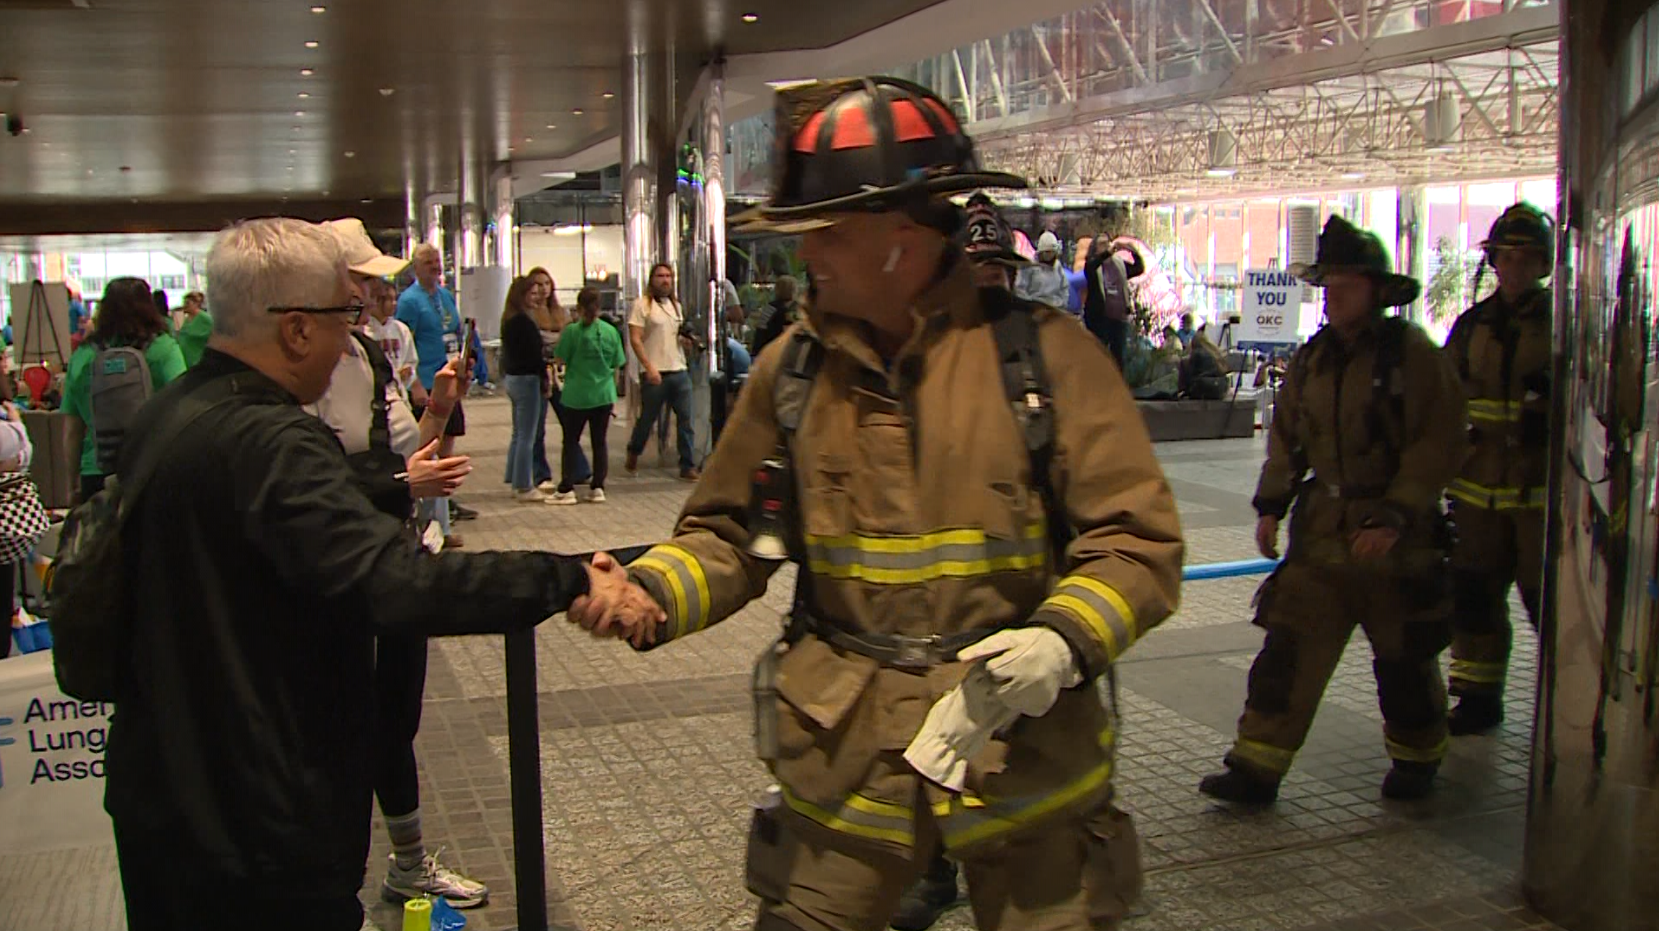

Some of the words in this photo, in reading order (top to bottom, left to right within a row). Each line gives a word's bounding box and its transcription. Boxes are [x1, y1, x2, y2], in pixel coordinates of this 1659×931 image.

[970, 224, 997, 241] 25
[1248, 272, 1297, 286] THANK
[1257, 291, 1287, 306] YOU
[1256, 315, 1283, 325] OKC
[28, 728, 106, 753] Lung
